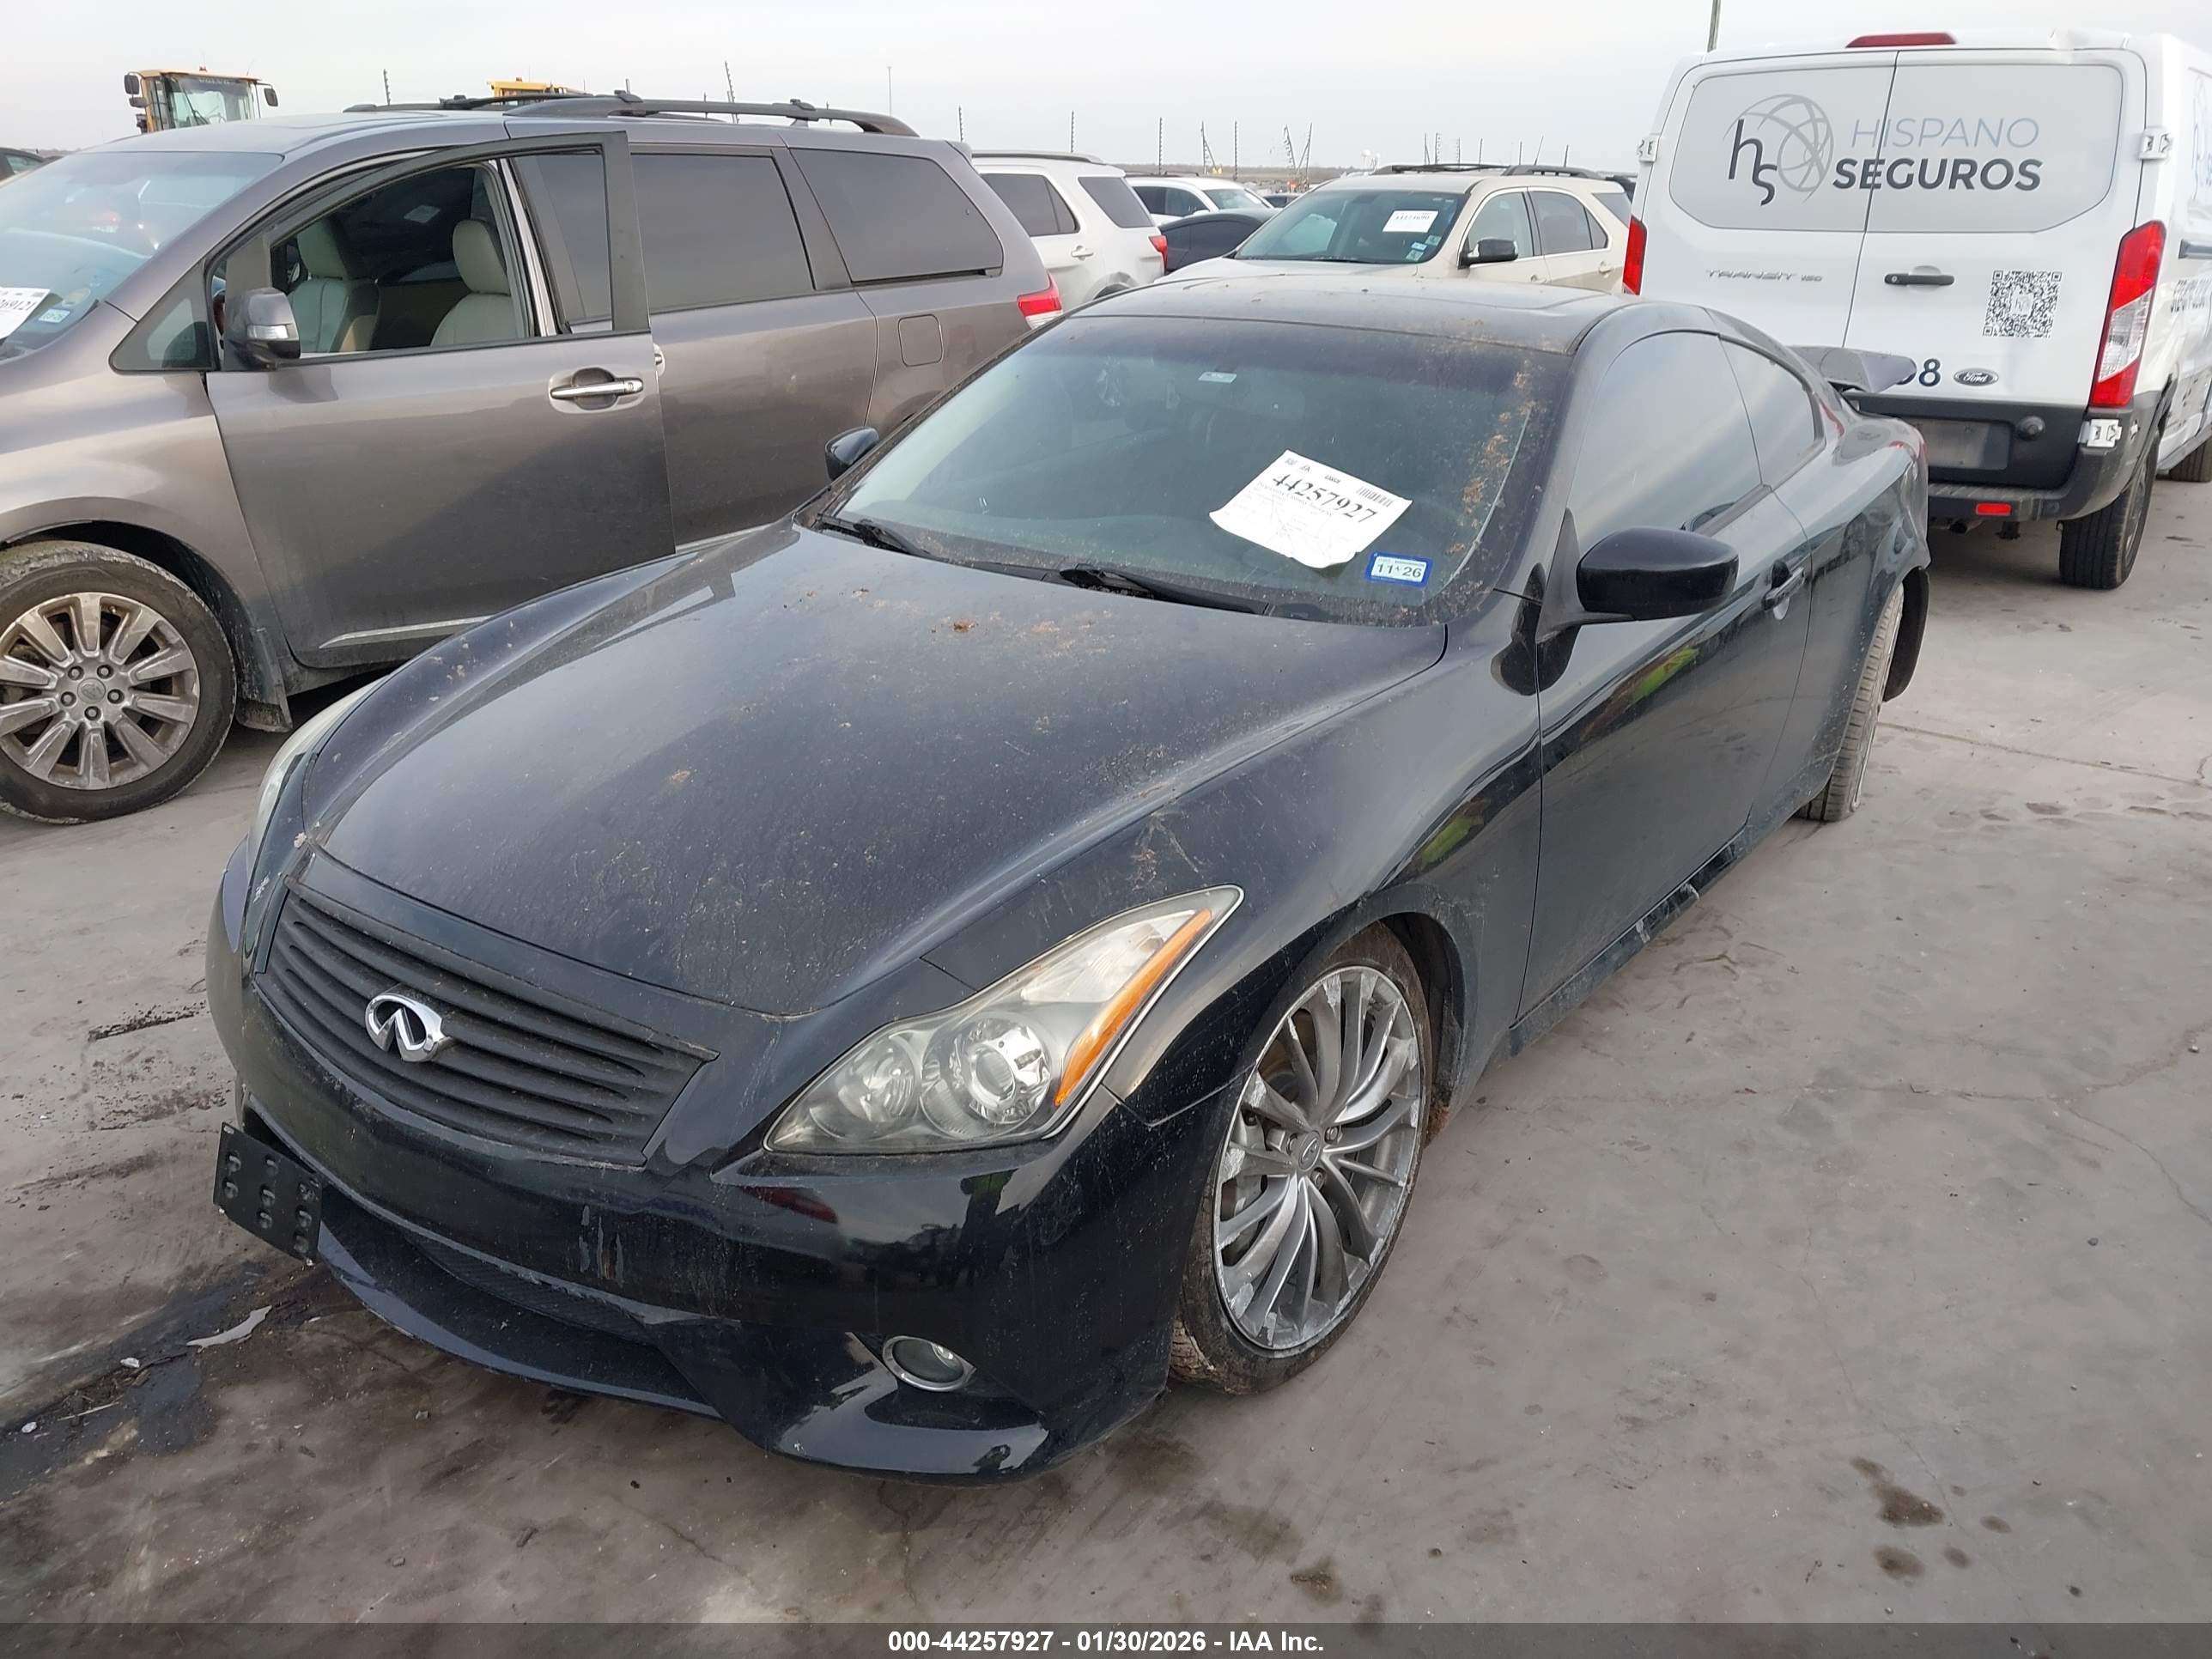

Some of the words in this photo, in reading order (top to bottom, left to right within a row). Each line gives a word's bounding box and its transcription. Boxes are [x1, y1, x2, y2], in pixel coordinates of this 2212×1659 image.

[1850, 117, 2040, 149] HISPANO
[1832, 157, 2044, 191] SEGUROS
[1273, 474, 1377, 523] 44257927
[1377, 563, 1394, 574] 11
[1401, 566, 1423, 578] 26
